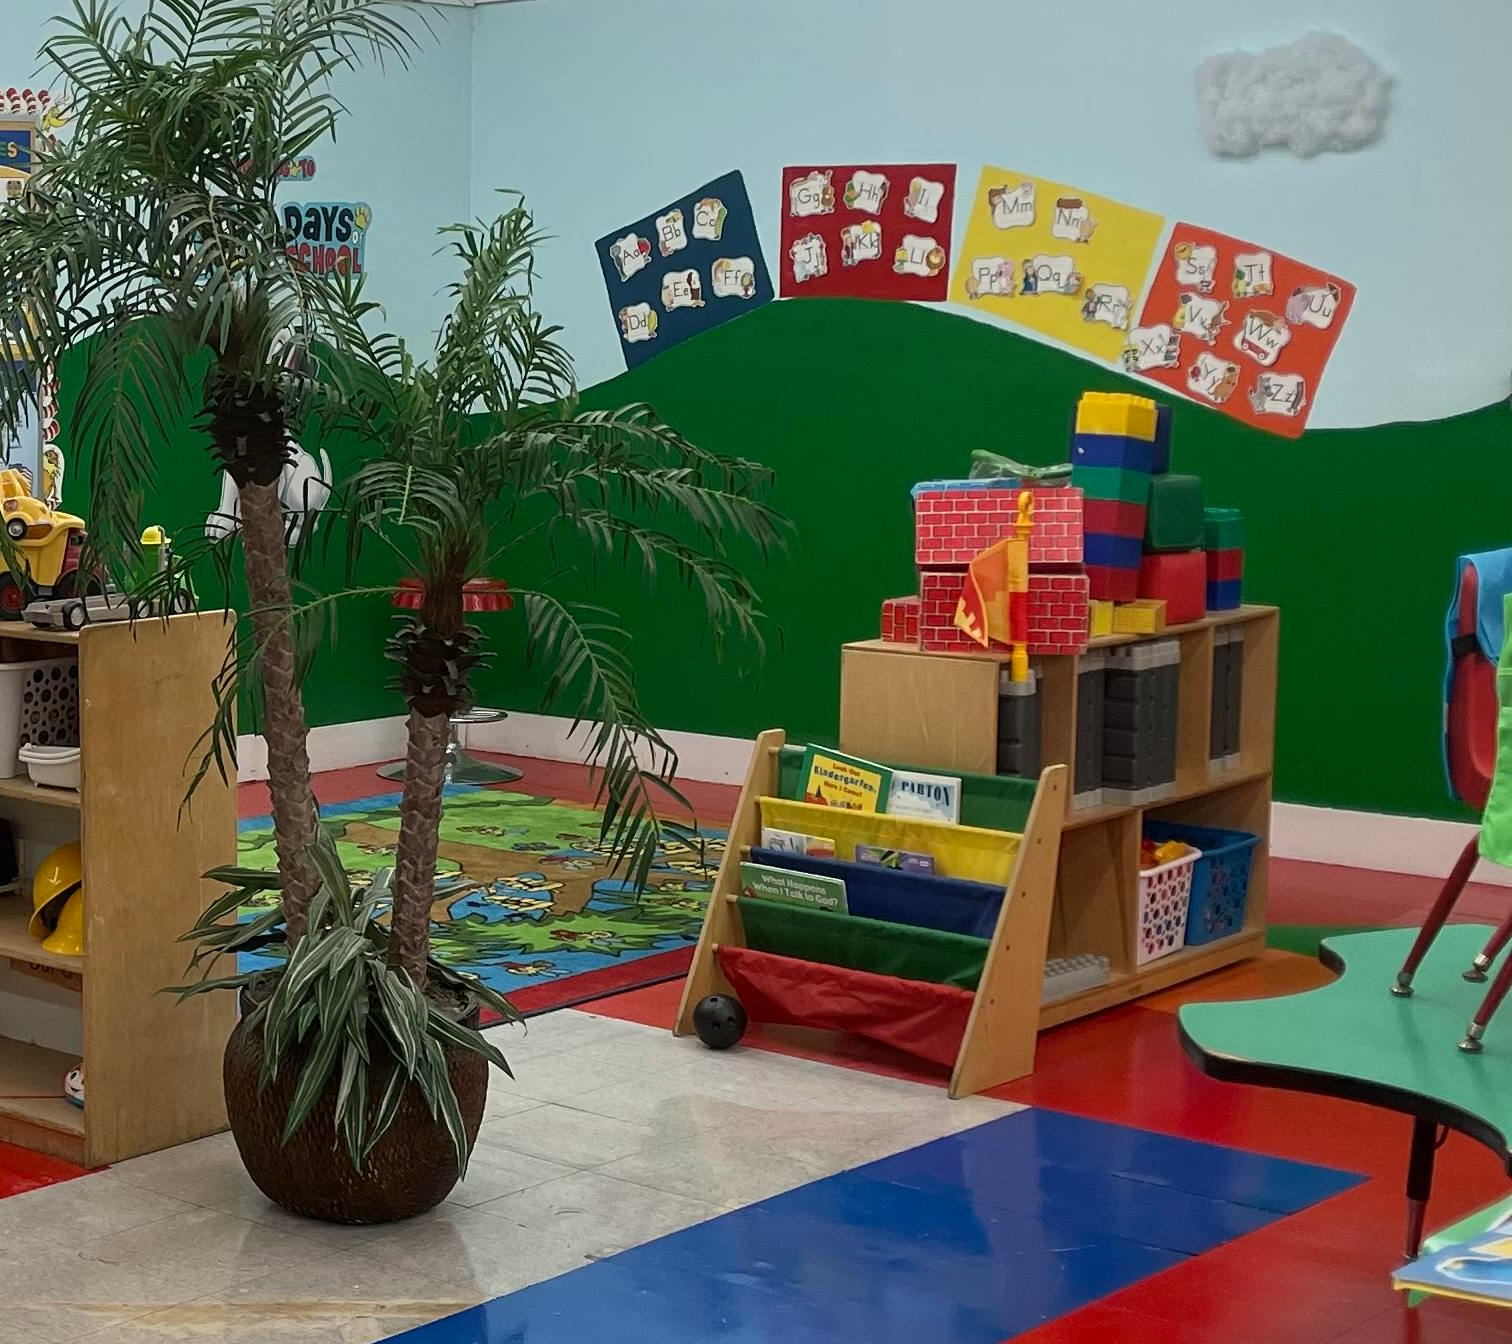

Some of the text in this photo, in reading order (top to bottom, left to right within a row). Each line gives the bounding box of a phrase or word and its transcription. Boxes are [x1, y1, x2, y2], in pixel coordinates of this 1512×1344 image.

[797, 188, 820, 209] Gg
[859, 183, 879, 202] Hh
[1001, 198, 1033, 215] Mm
[1056, 209, 1080, 227] Nn
[662, 226, 681, 241] Bb
[285, 242, 362, 277] SCHOOL
[1186, 258, 1206, 274] Ss
[1244, 264, 1267, 282] Tt
[1309, 294, 1332, 318] Uu
[628, 314, 647, 330] Dd
[761, 874, 826, 895] What Happens
[752, 882, 779, 895] When
[785, 887, 803, 899] Talk
[804, 891, 814, 901] to
[815, 894, 838, 907] God?
